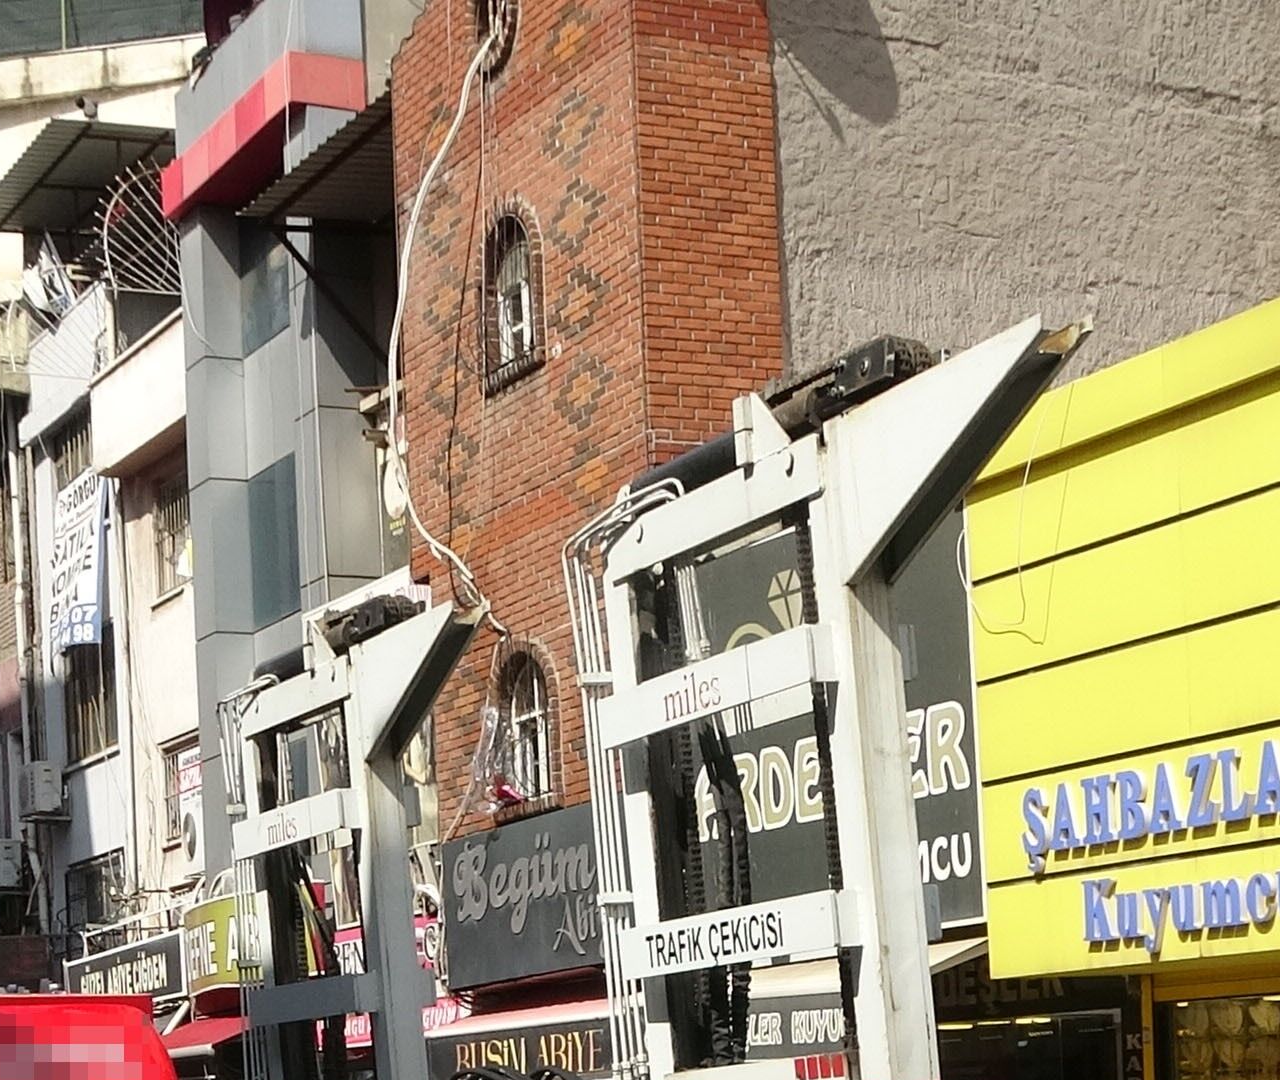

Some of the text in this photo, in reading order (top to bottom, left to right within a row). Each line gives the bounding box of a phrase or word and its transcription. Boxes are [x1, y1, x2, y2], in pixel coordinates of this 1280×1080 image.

[663, 672, 722, 723] miles
[267, 812, 298, 846] miles
[453, 832, 597, 935] Begüm
[645, 911, 784, 969] TRAFİK ÇEKİCİSİ
[746, 1008, 846, 1046] LER KUYU
